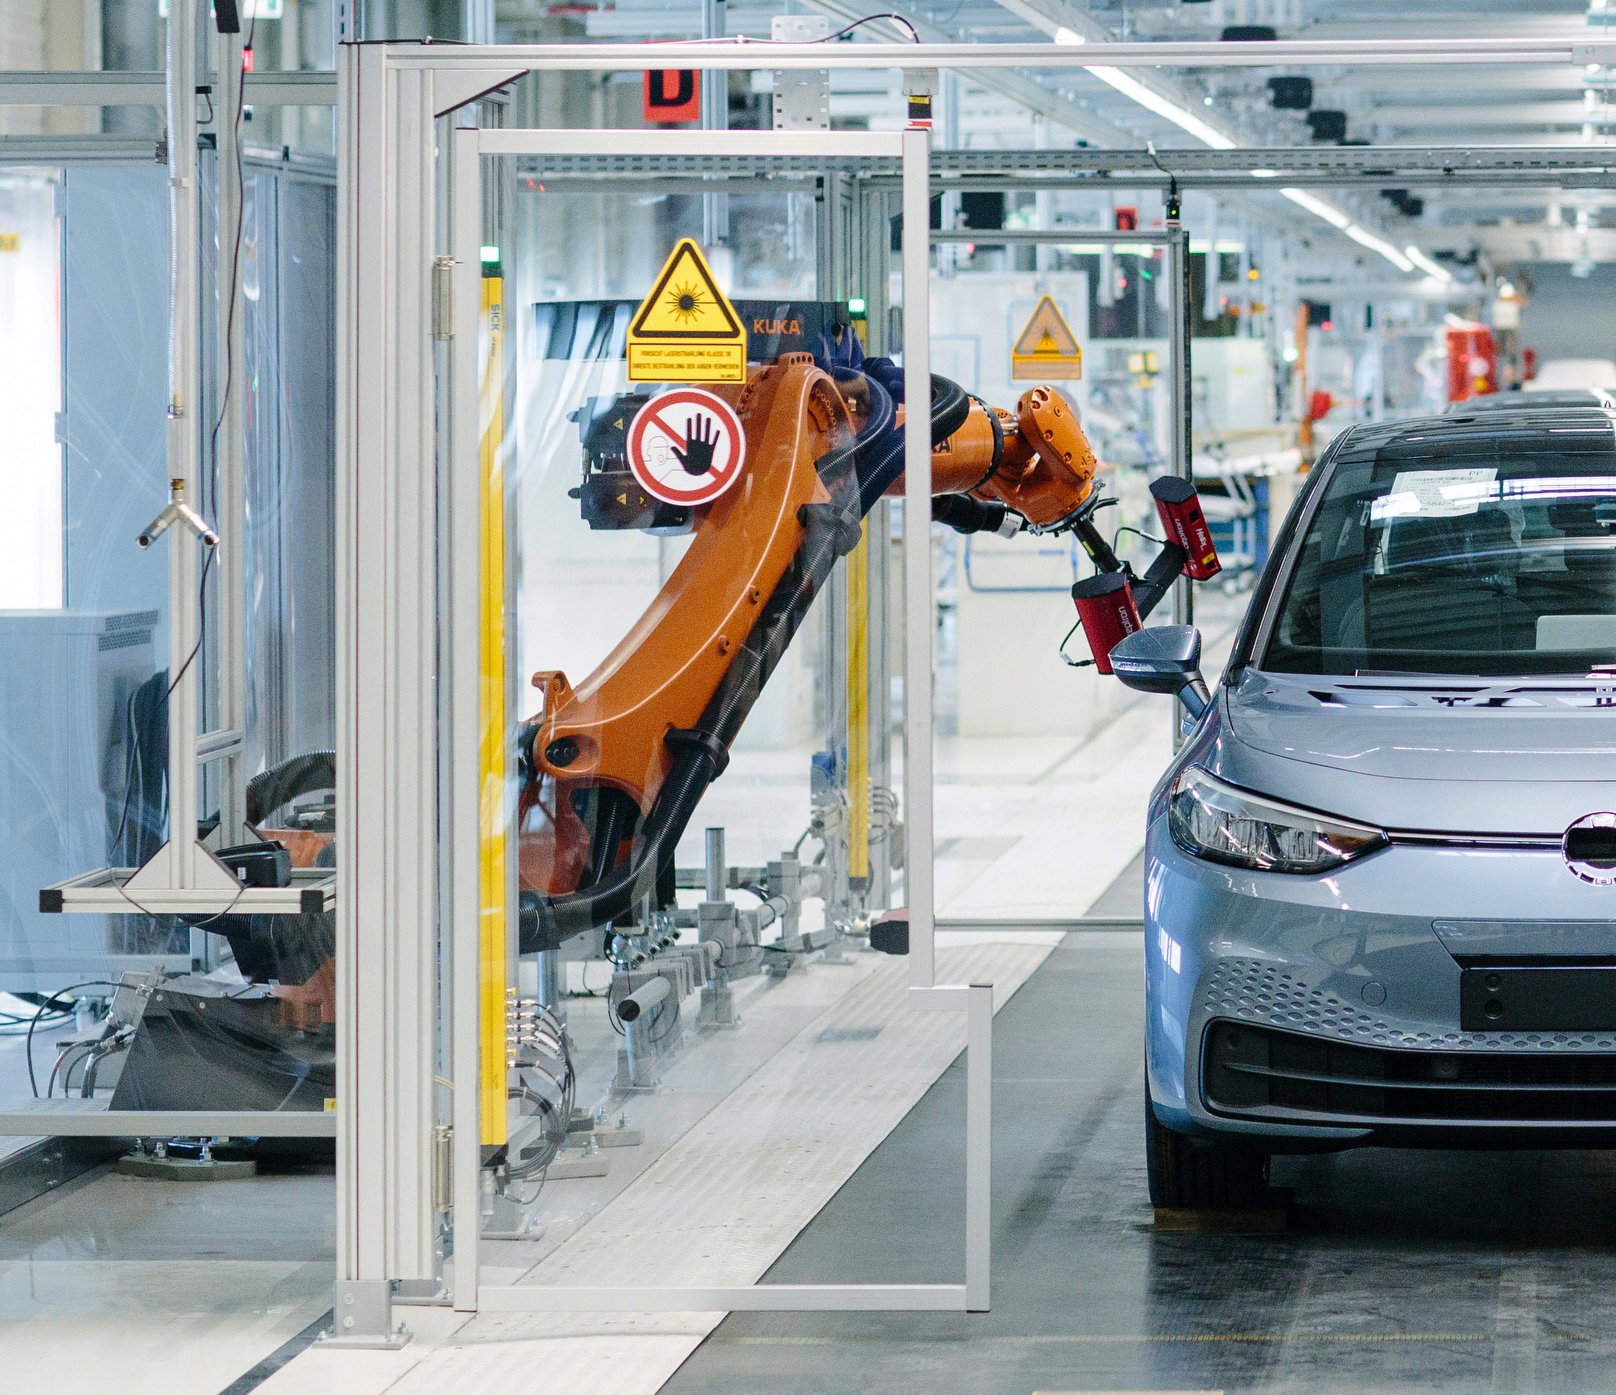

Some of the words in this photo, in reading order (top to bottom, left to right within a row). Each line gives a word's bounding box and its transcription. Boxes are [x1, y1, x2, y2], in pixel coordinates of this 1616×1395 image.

[490, 304, 500, 331] SICK
[753, 319, 801, 335] KUKA
[1118, 606, 1133, 635] eptron
